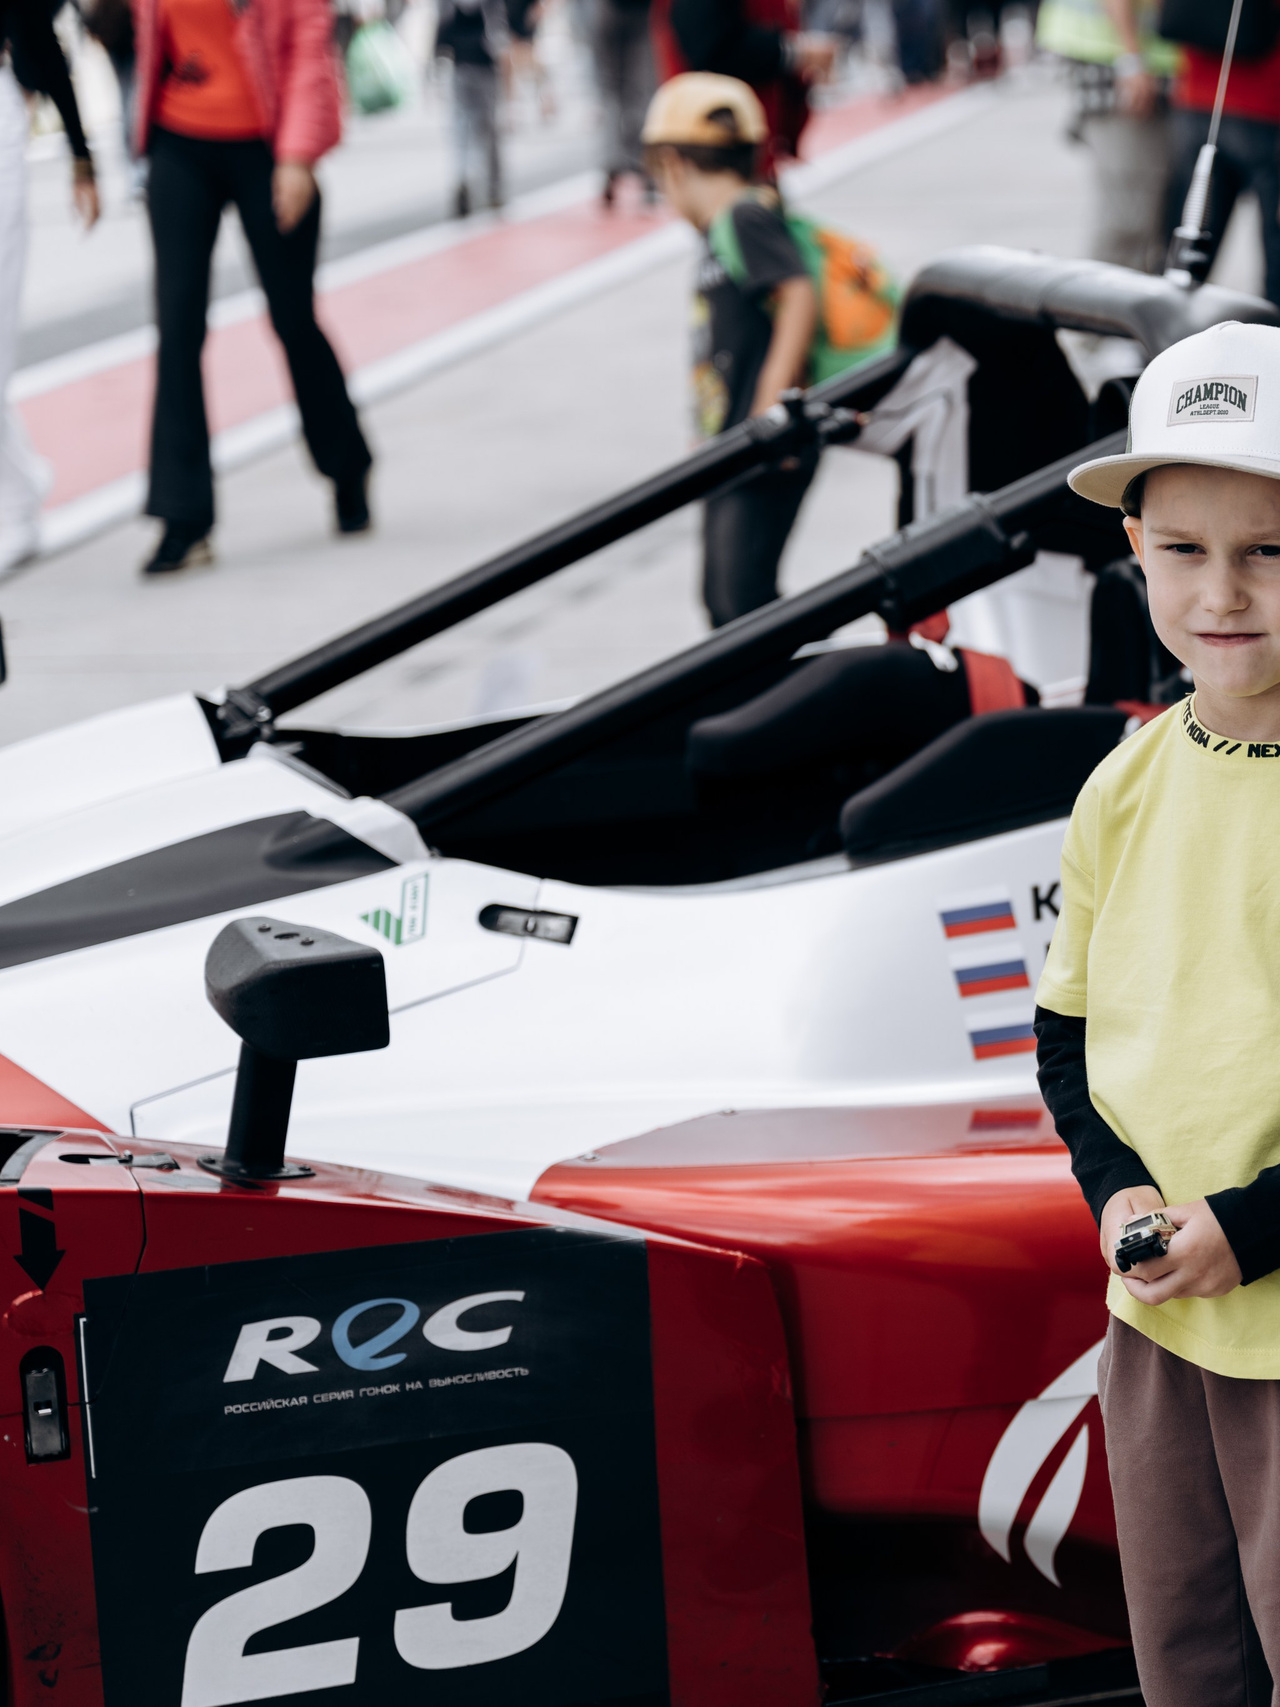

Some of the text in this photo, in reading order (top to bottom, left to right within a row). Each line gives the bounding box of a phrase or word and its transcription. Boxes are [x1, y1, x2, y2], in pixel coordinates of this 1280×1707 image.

[1176, 382, 1247, 414] CHAMPION
[1186, 721, 1211, 749] NOW
[224, 1367, 530, 1415] РОССИЙСКАЯ СЕРИЯ ГОНОК НА ВЫНОСЛИВОСТЬ
[181, 1442, 578, 1707] 29
